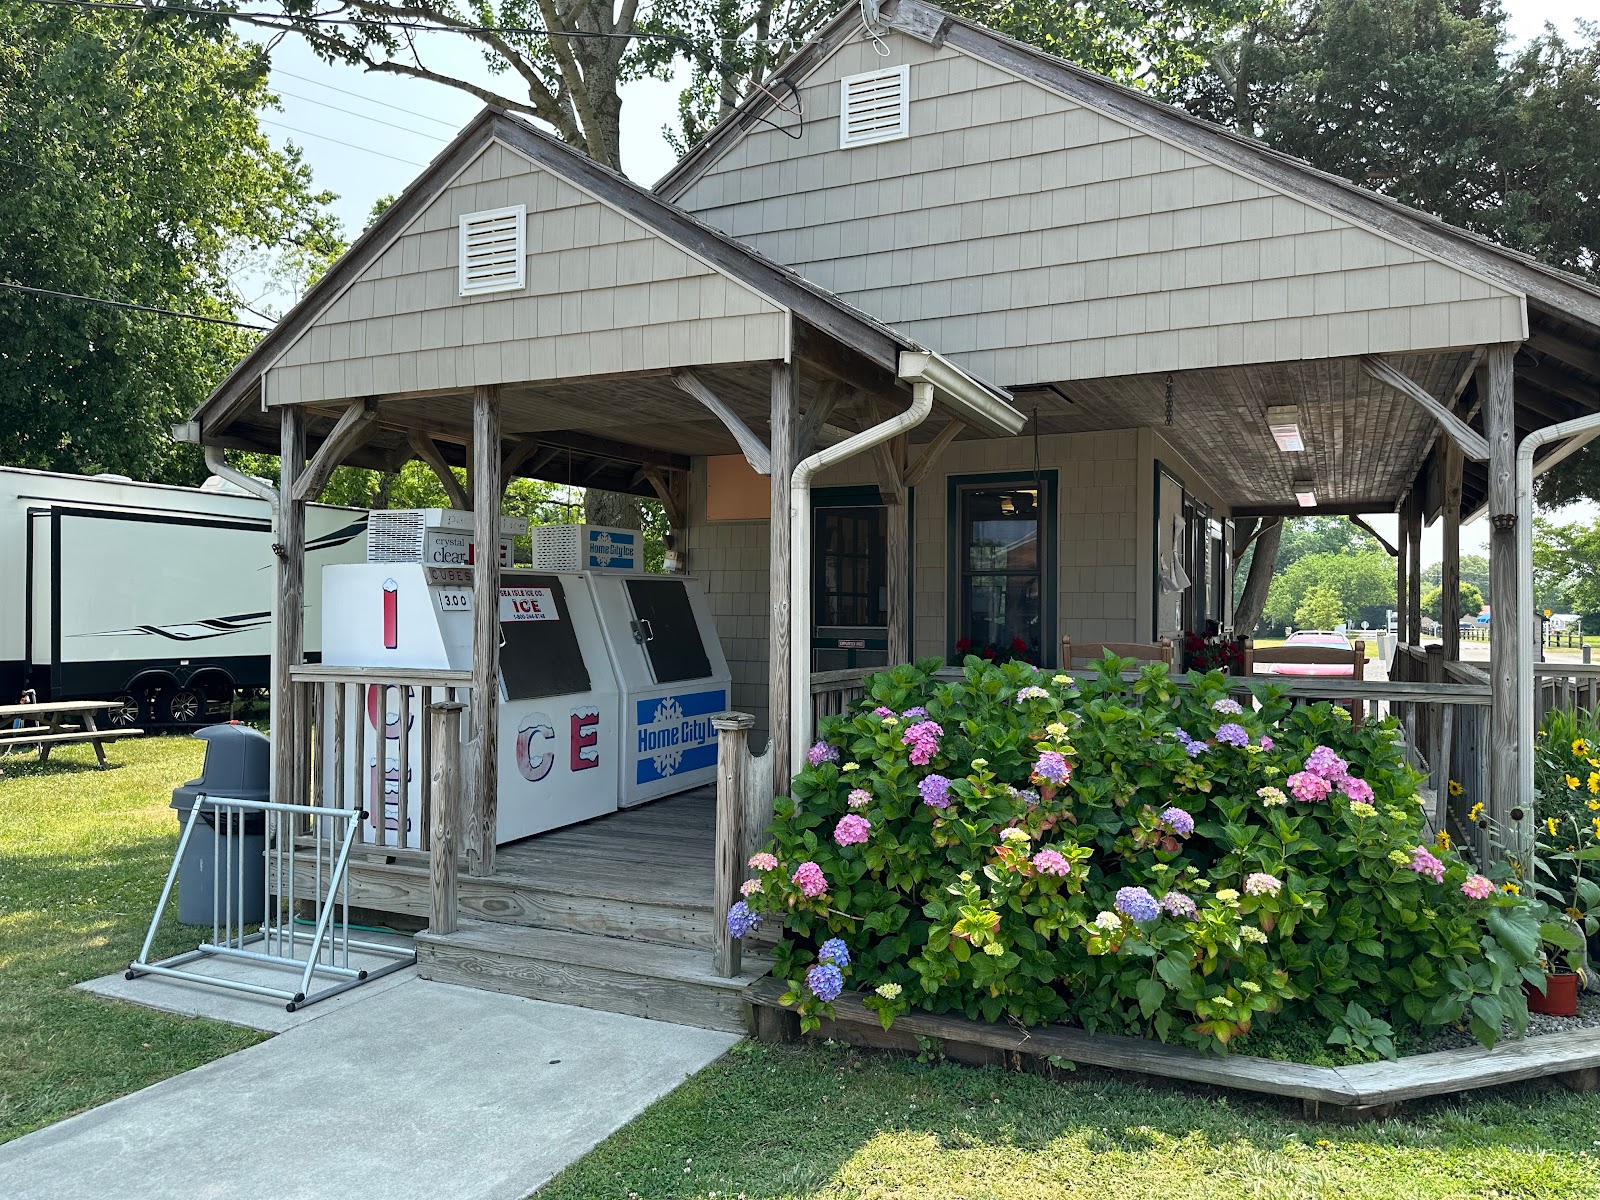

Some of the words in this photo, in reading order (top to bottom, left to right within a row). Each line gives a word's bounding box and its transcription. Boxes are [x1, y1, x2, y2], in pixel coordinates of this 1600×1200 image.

[435, 538, 465, 547] crystal
[433, 547, 466, 563] clear
[590, 543, 609, 554] Home
[610, 545, 623, 557] City
[623, 546, 633, 556] Ice
[432, 569, 472, 580] CUBES
[444, 595, 467, 606] 3.00
[512, 599, 541, 613] ICE
[638, 728, 679, 753] Home
[681, 720, 706, 745] City
[707, 717, 718, 738] Ic
